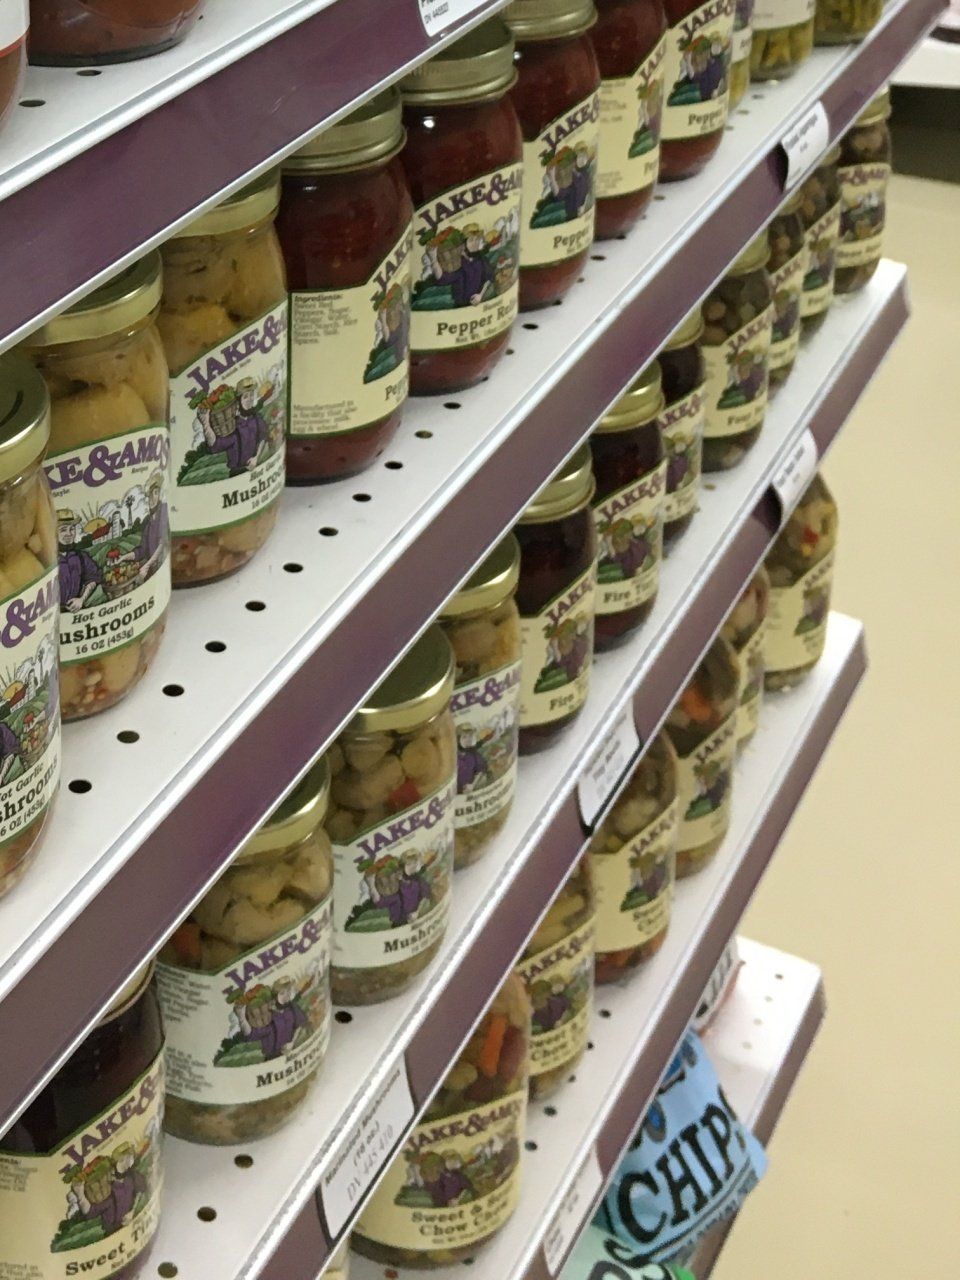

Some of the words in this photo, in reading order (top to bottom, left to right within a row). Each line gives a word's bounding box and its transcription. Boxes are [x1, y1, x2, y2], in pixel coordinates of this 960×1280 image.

[436, 316, 494, 338] Pepper
[603, 589, 632, 604] Fire
[59, 594, 157, 646] ushrooms
[72, 608, 96, 626] Hot
[95, 595, 134, 620] Garlic
[74, 642, 90, 656] 16
[90, 638, 107, 654] OZ
[107, 627, 135, 649] (453g)
[15, 761, 45, 794] Garlic
[9, 816, 24, 834] OZ
[411, 1209, 465, 1227] Sweet
[419, 1218, 468, 1237] Chow
[65, 1240, 126, 1277] Sweet
